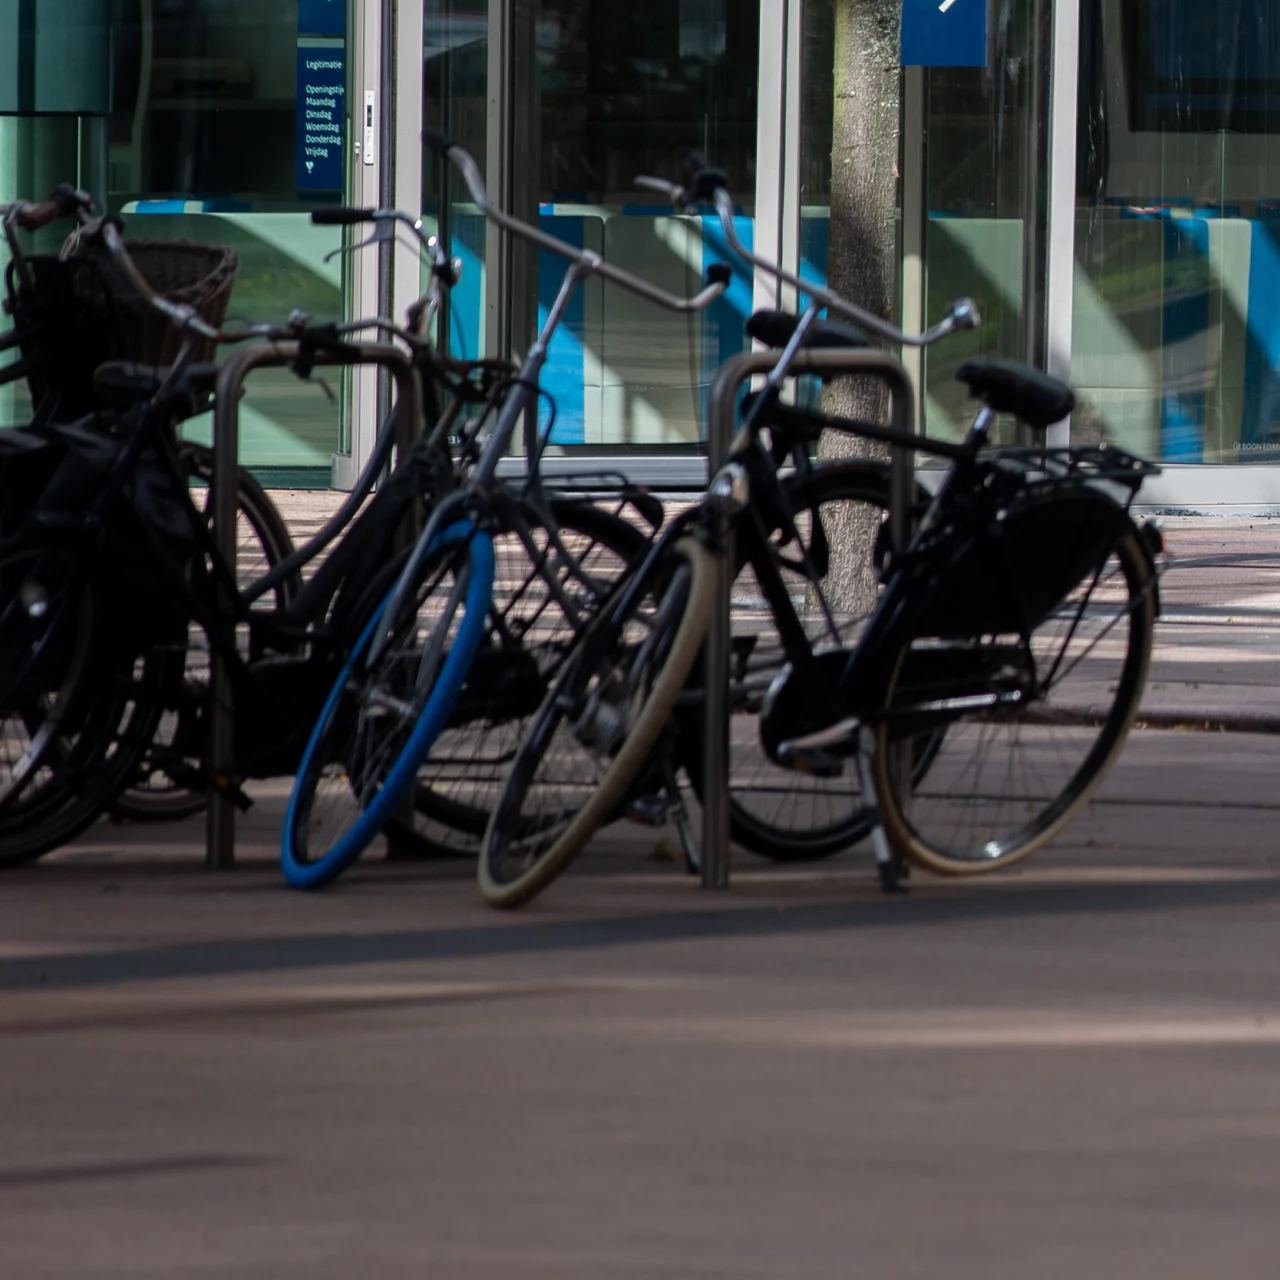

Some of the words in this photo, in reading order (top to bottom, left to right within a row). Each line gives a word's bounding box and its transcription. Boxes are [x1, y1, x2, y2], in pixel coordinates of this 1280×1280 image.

[306, 60, 342, 70] Legitimatie
[306, 97, 336, 108] Maandag
[306, 109, 332, 120] Dinsdag
[305, 122, 339, 133] Woensdag
[305, 134, 341, 146] Donderdag
[305, 147, 328, 158] Vrijdag
[1242, 443, 1262, 451] BOON
